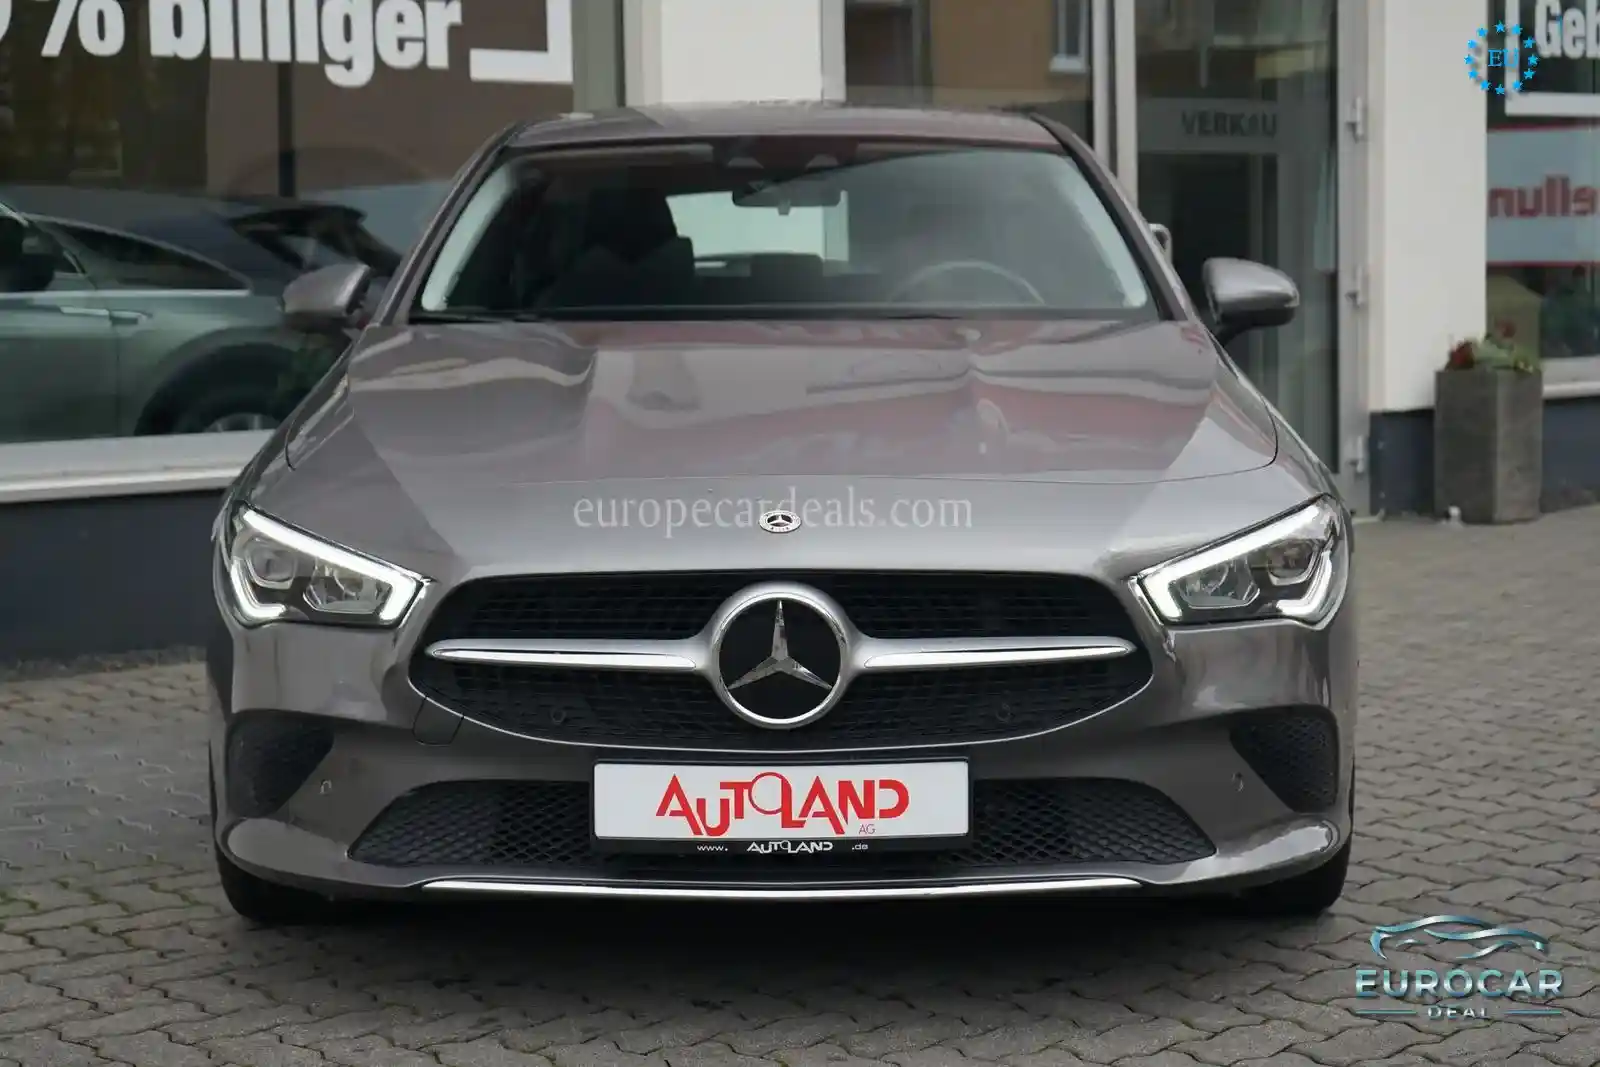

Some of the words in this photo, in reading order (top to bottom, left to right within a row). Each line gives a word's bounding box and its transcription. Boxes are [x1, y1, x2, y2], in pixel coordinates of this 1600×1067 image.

[149, 0, 462, 87] billiger
[656, 771, 909, 836] AUTOLAND
[747, 840, 833, 854] AUTOLAND
[858, 824, 875, 834] AG
